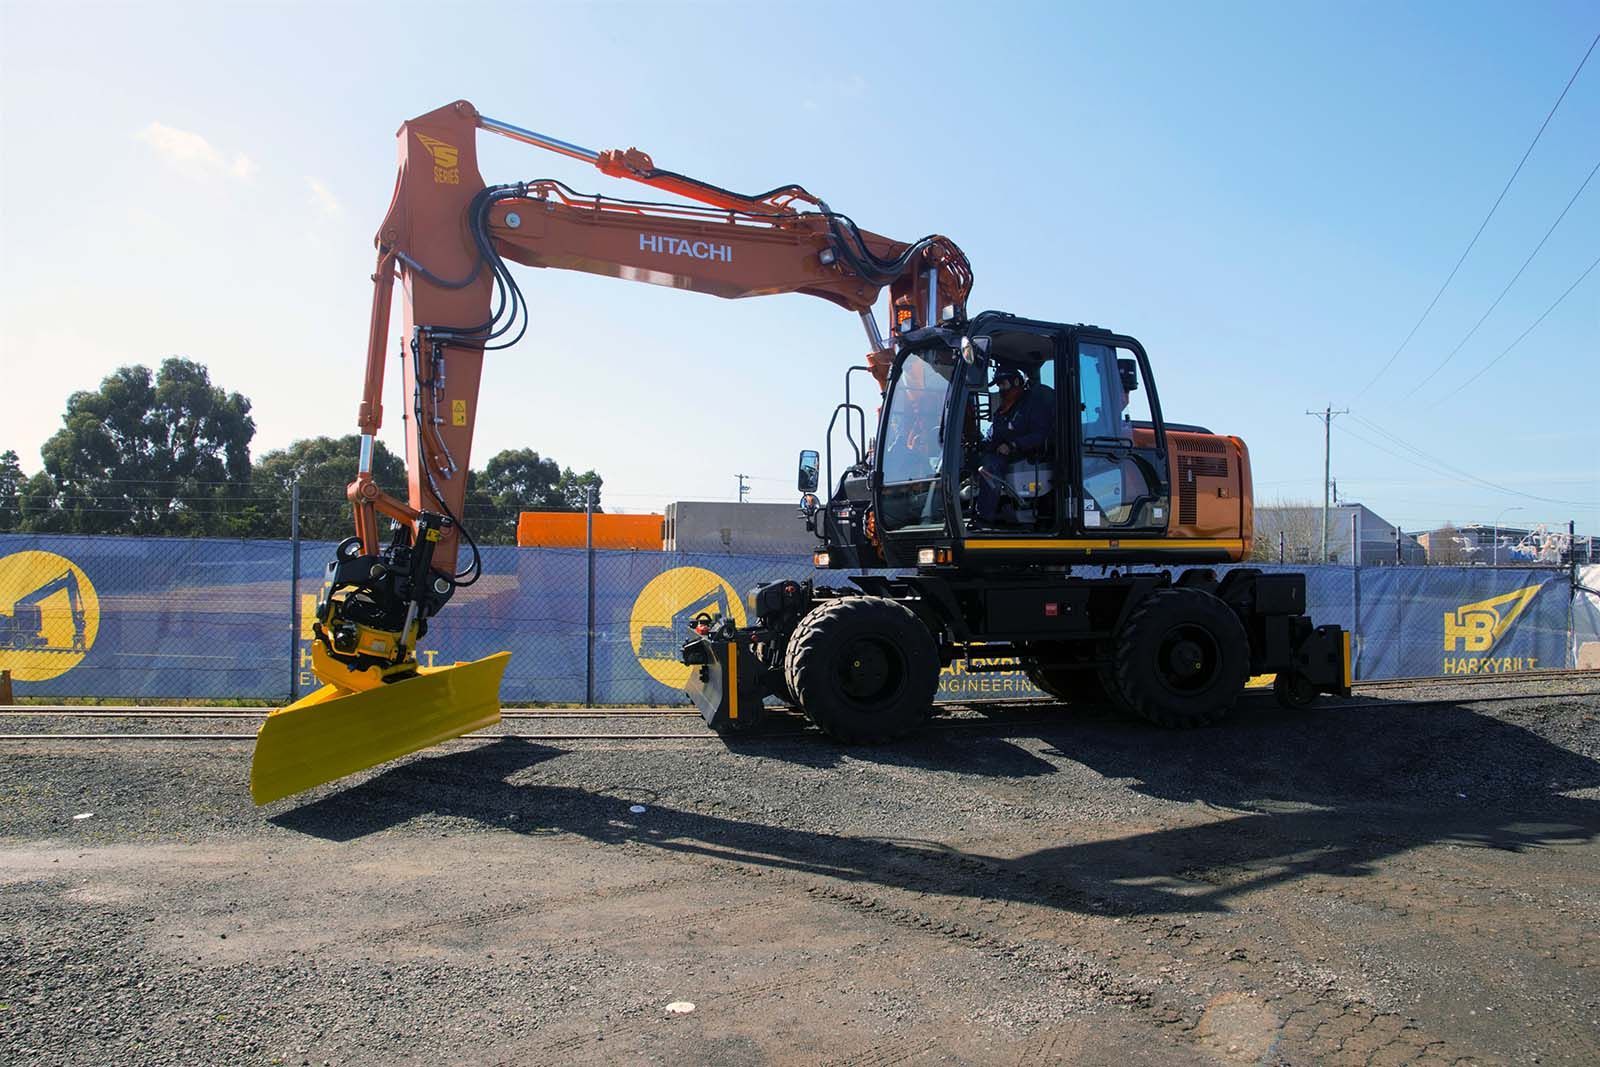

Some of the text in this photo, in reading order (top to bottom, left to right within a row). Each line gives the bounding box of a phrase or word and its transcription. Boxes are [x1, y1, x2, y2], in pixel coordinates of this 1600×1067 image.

[433, 167, 459, 185] SERIES
[639, 233, 732, 262] HITACHI
[1444, 612, 1495, 652] HB
